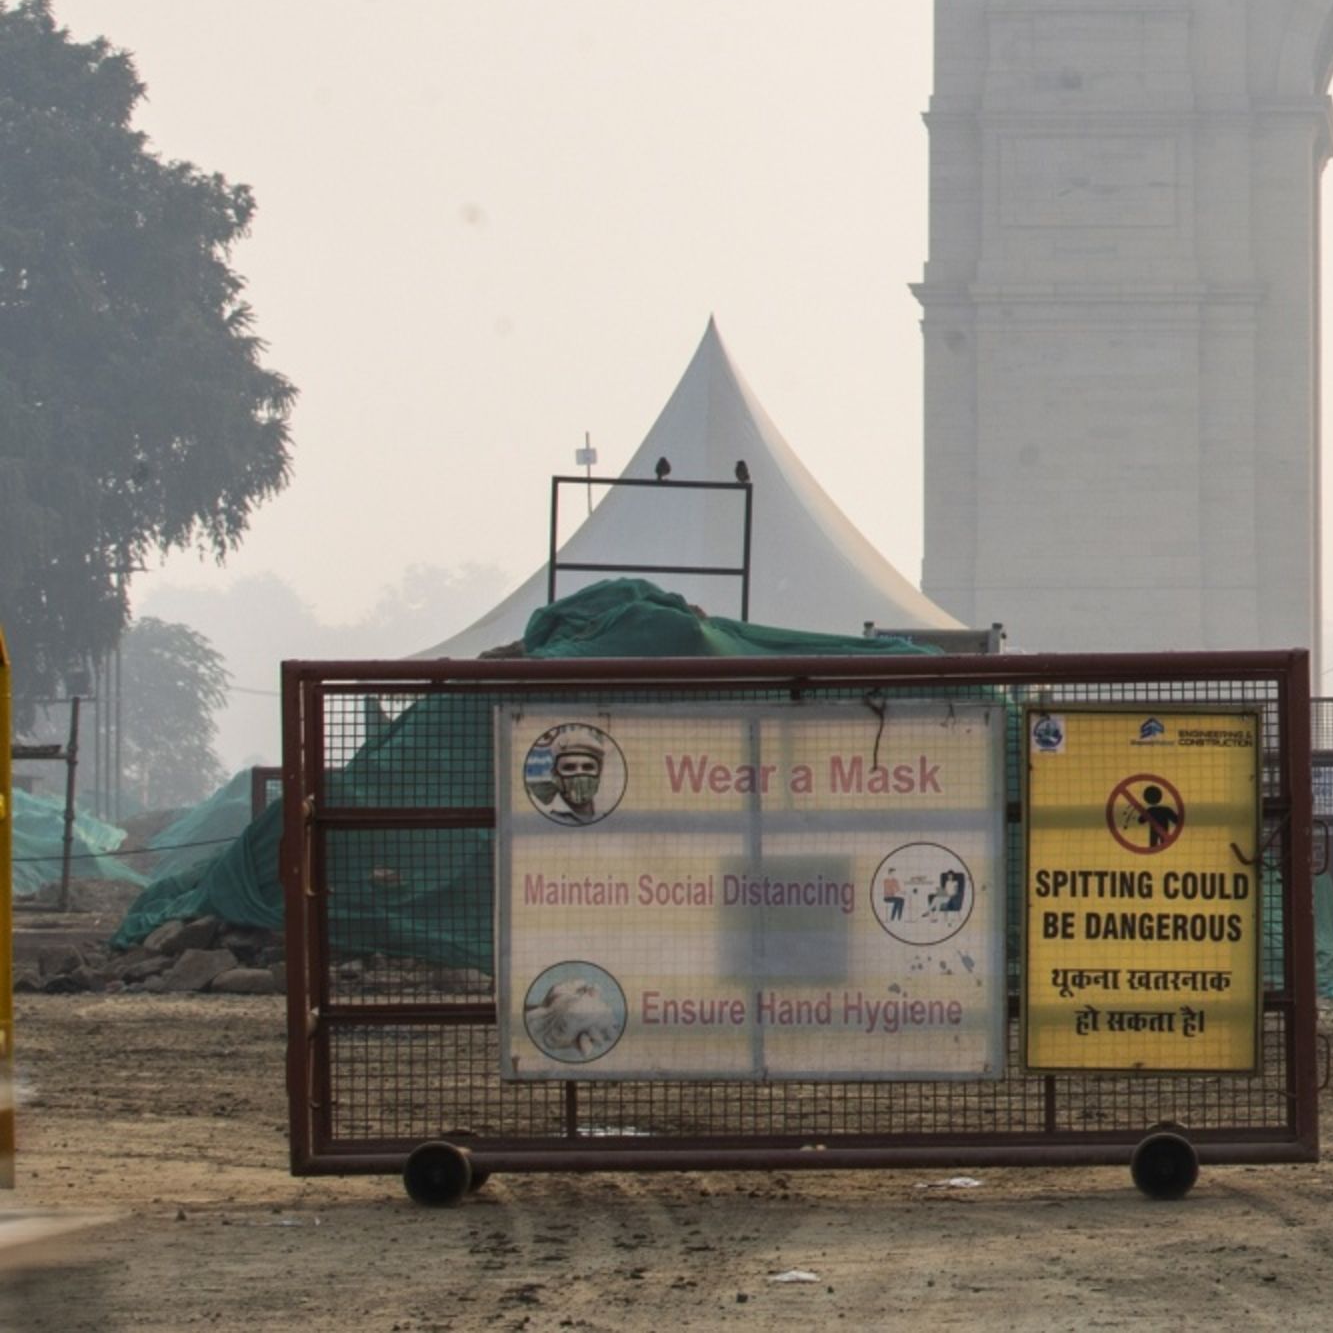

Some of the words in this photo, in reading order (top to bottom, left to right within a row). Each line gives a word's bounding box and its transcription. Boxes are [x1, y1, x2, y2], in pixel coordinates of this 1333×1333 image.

[1177, 730, 1244, 738] ENGINEERING
[1177, 738, 1253, 748] CONSTRUCTION
[665, 755, 776, 794] Wear
[790, 764, 813, 794] a
[829, 754, 942, 794] Mask
[523, 873, 629, 907] Maintain
[637, 873, 714, 907] Social
[723, 874, 856, 914] Distancing
[1035, 869, 1153, 900] SPITTING
[1163, 870, 1250, 901] COULD
[1042, 911, 1075, 940] BE
[1085, 912, 1242, 943] DANGEROUS
[1051, 968, 1121, 998] थूकना
[1126, 969, 1232, 993] खतरनाक
[641, 990, 746, 1026] Ensure
[756, 990, 833, 1026] Hand
[843, 990, 963, 1034] Hygiene
[1074, 1004, 1100, 1036] हो
[1106, 1009, 1176, 1033] सकता
